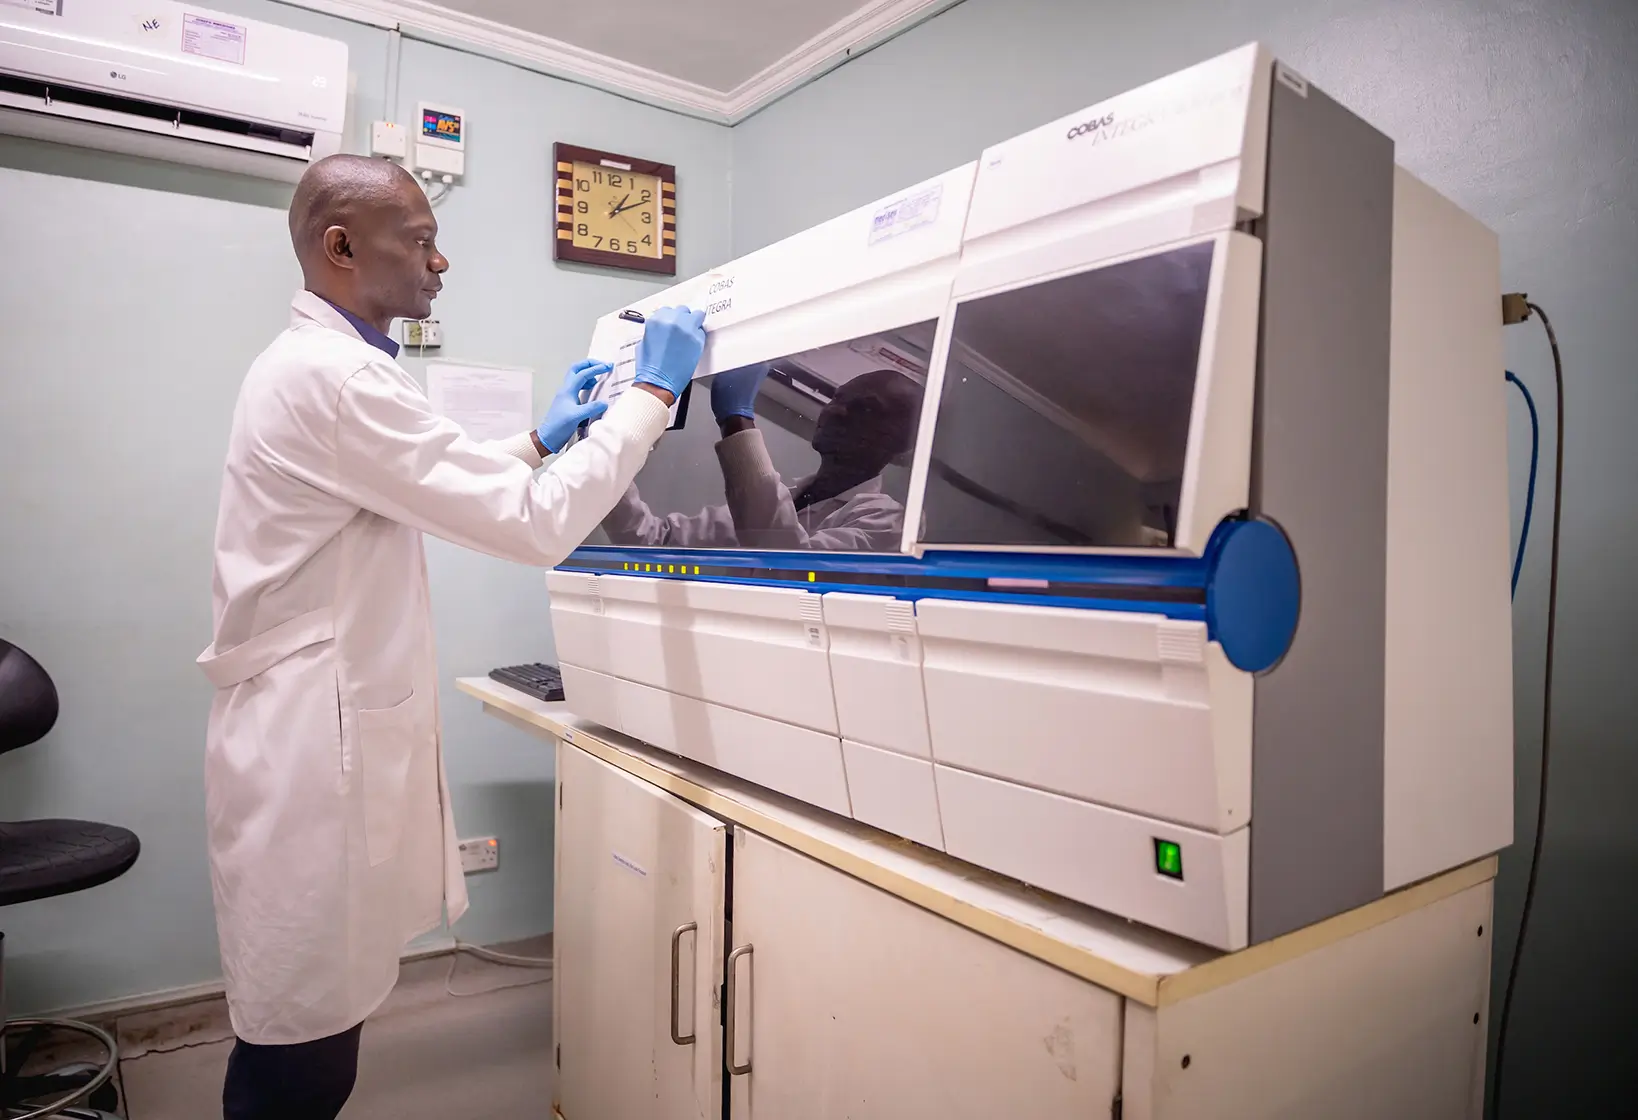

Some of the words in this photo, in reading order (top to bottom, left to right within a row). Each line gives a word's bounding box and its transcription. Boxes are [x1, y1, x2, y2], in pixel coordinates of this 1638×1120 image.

[1066, 111, 1115, 140] COBAS
[592, 171, 602, 184] 11
[607, 174, 622, 188] 12
[629, 177, 634, 190] 1
[576, 178, 590, 192] 10
[641, 190, 651, 202] 2
[577, 201, 588, 214] 9
[641, 212, 651, 224] 3
[577, 223, 588, 236] 8
[592, 235, 603, 248] 7
[609, 238, 620, 251] 6
[627, 241, 637, 253] 5
[641, 235, 652, 246] 4
[708, 276, 735, 295] COBAS
[704, 298, 732, 316] TEGRA
